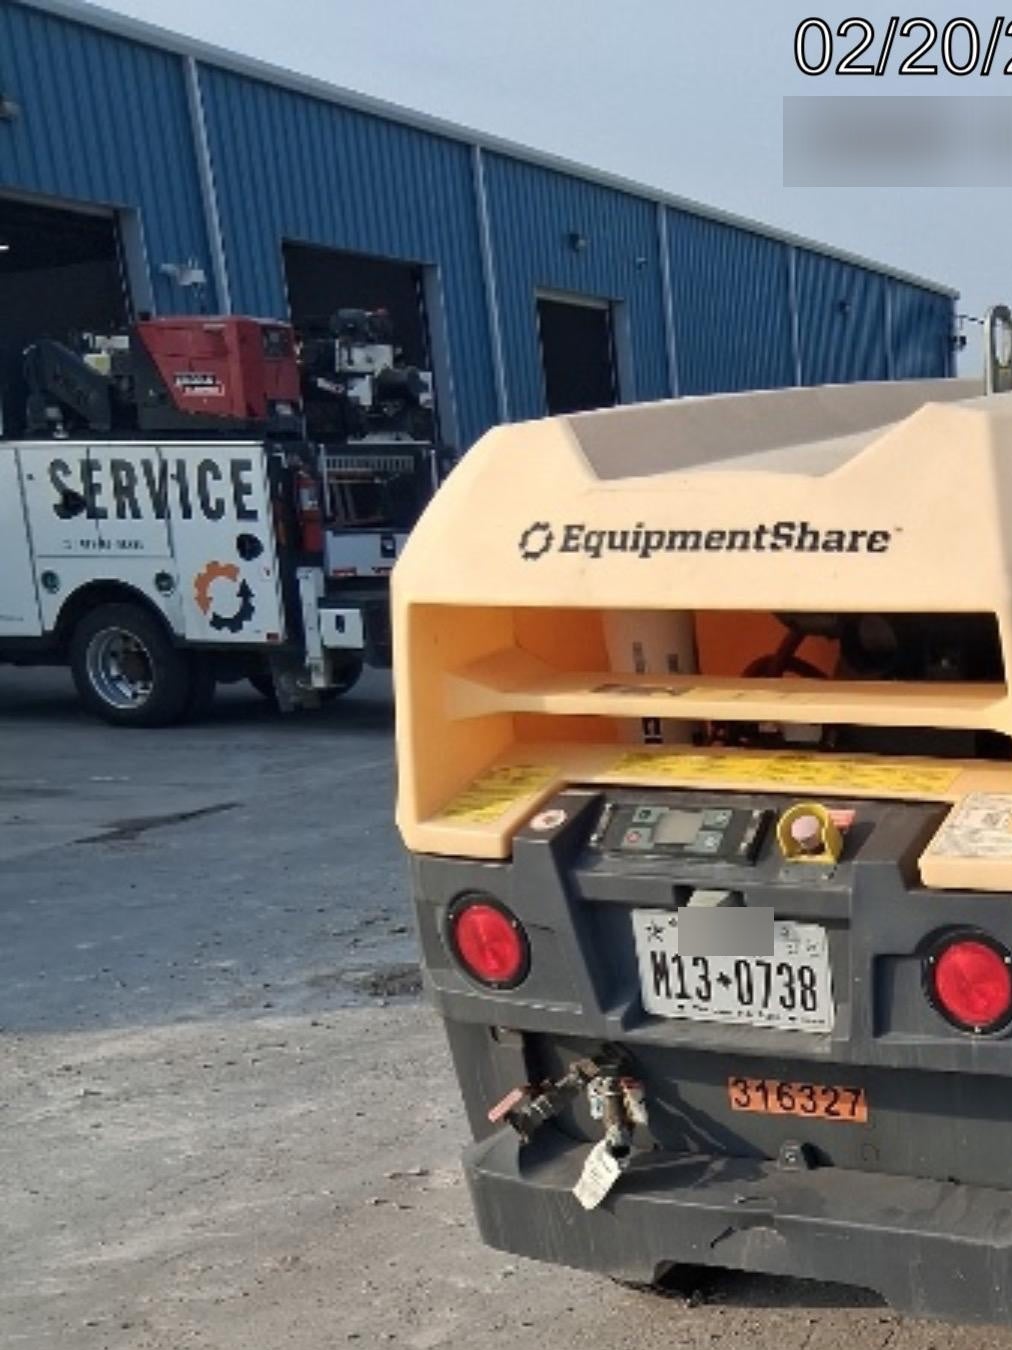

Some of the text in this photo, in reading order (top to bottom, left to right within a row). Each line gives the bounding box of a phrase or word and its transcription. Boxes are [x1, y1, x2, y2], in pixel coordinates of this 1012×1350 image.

[49, 458, 258, 520] SERVICE
[559, 521, 892, 558] EquipmentShare
[732, 1078, 862, 1117] 316327
